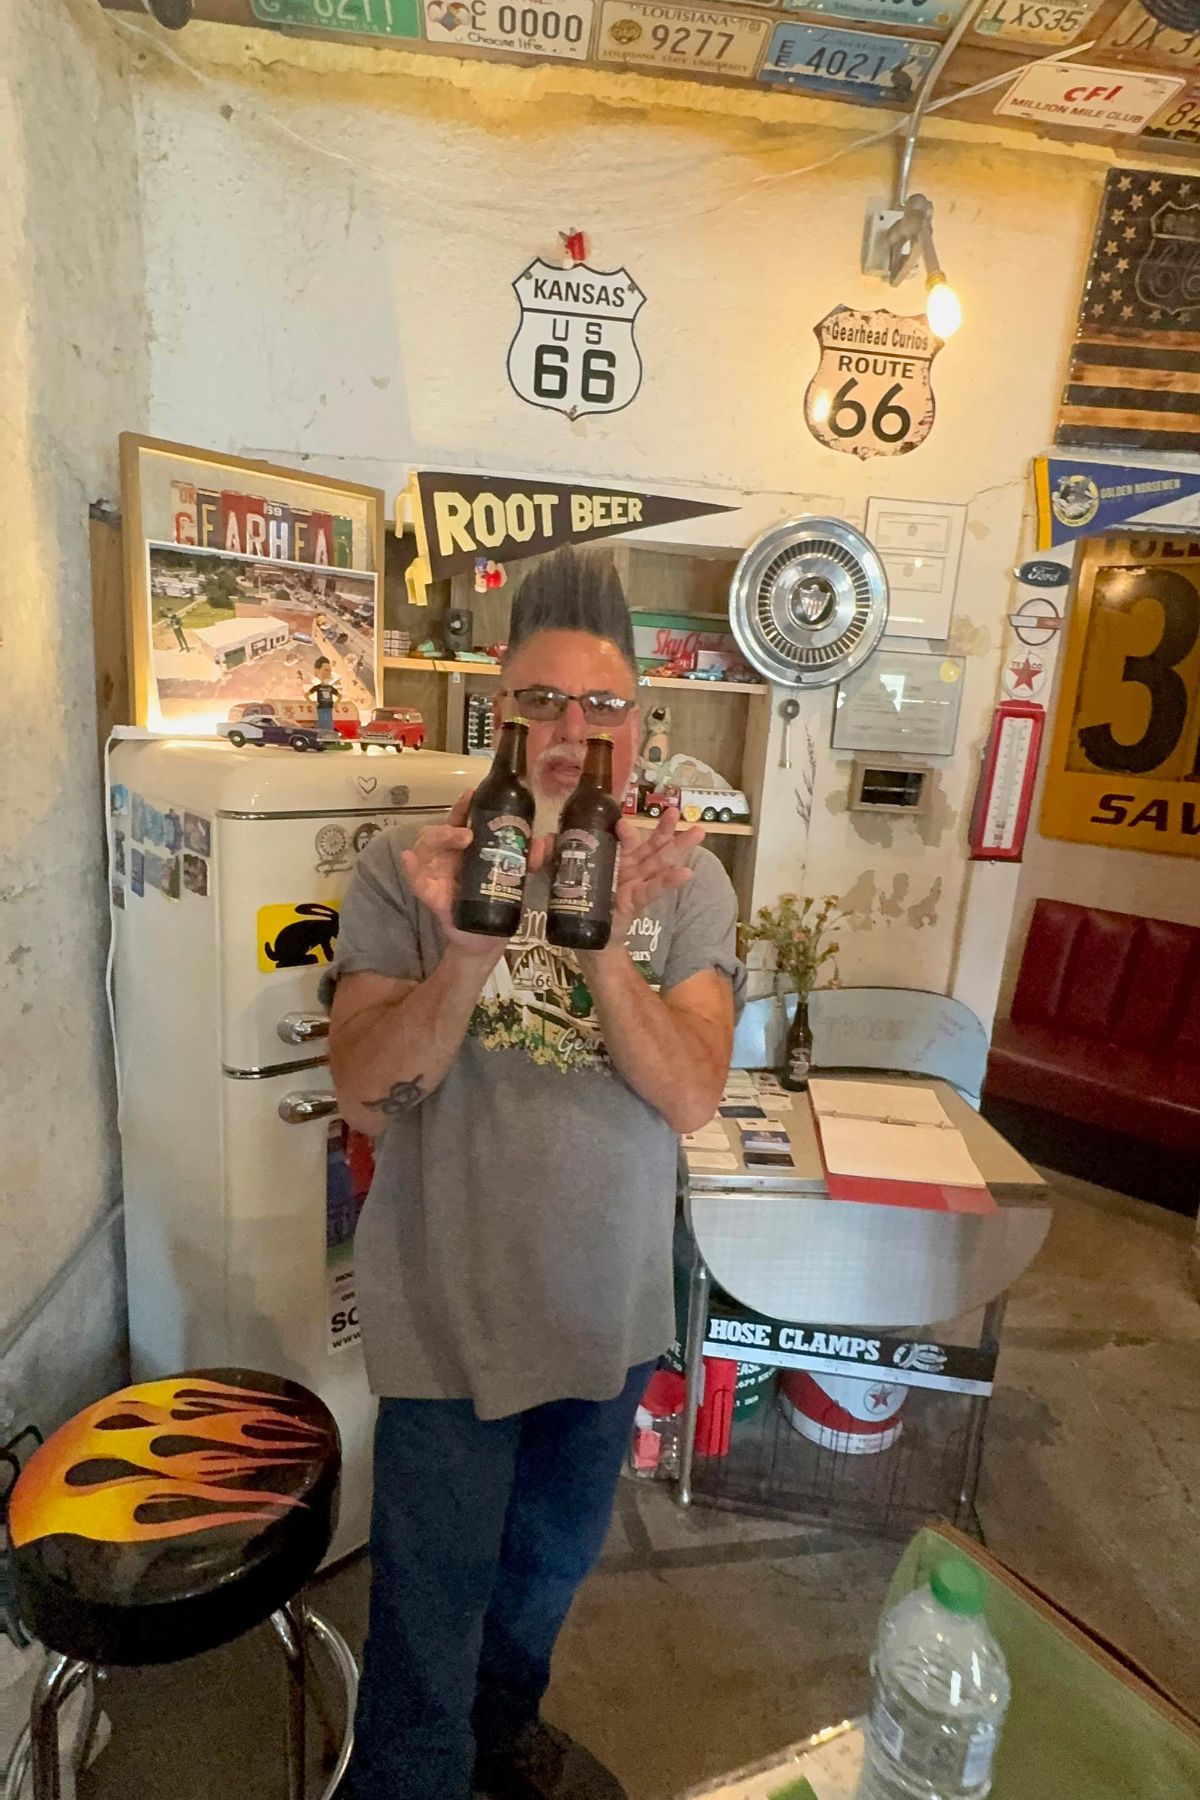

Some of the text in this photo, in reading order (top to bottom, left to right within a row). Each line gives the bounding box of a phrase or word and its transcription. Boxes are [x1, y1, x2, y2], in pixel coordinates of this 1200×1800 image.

[499, 5, 583, 43] 0000
[641, 7, 730, 27] LOUISIANA
[467, 31, 515, 48] Choose
[651, 24, 735, 60] 9277
[805, 46, 886, 83] 4021
[1010, 97, 1144, 124] MILLION MILE CLUB
[533, 277, 626, 308] KANSAS
[831, 320, 929, 351] Gearhead Curios
[533, 343, 616, 404] 66
[837, 354, 915, 380] ROUTE
[827, 376, 911, 443] 66
[432, 491, 643, 557] ROOT BEER
[1027, 564, 1061, 583] Ford
[708, 1318, 881, 1362] HOSE CLAMPS
